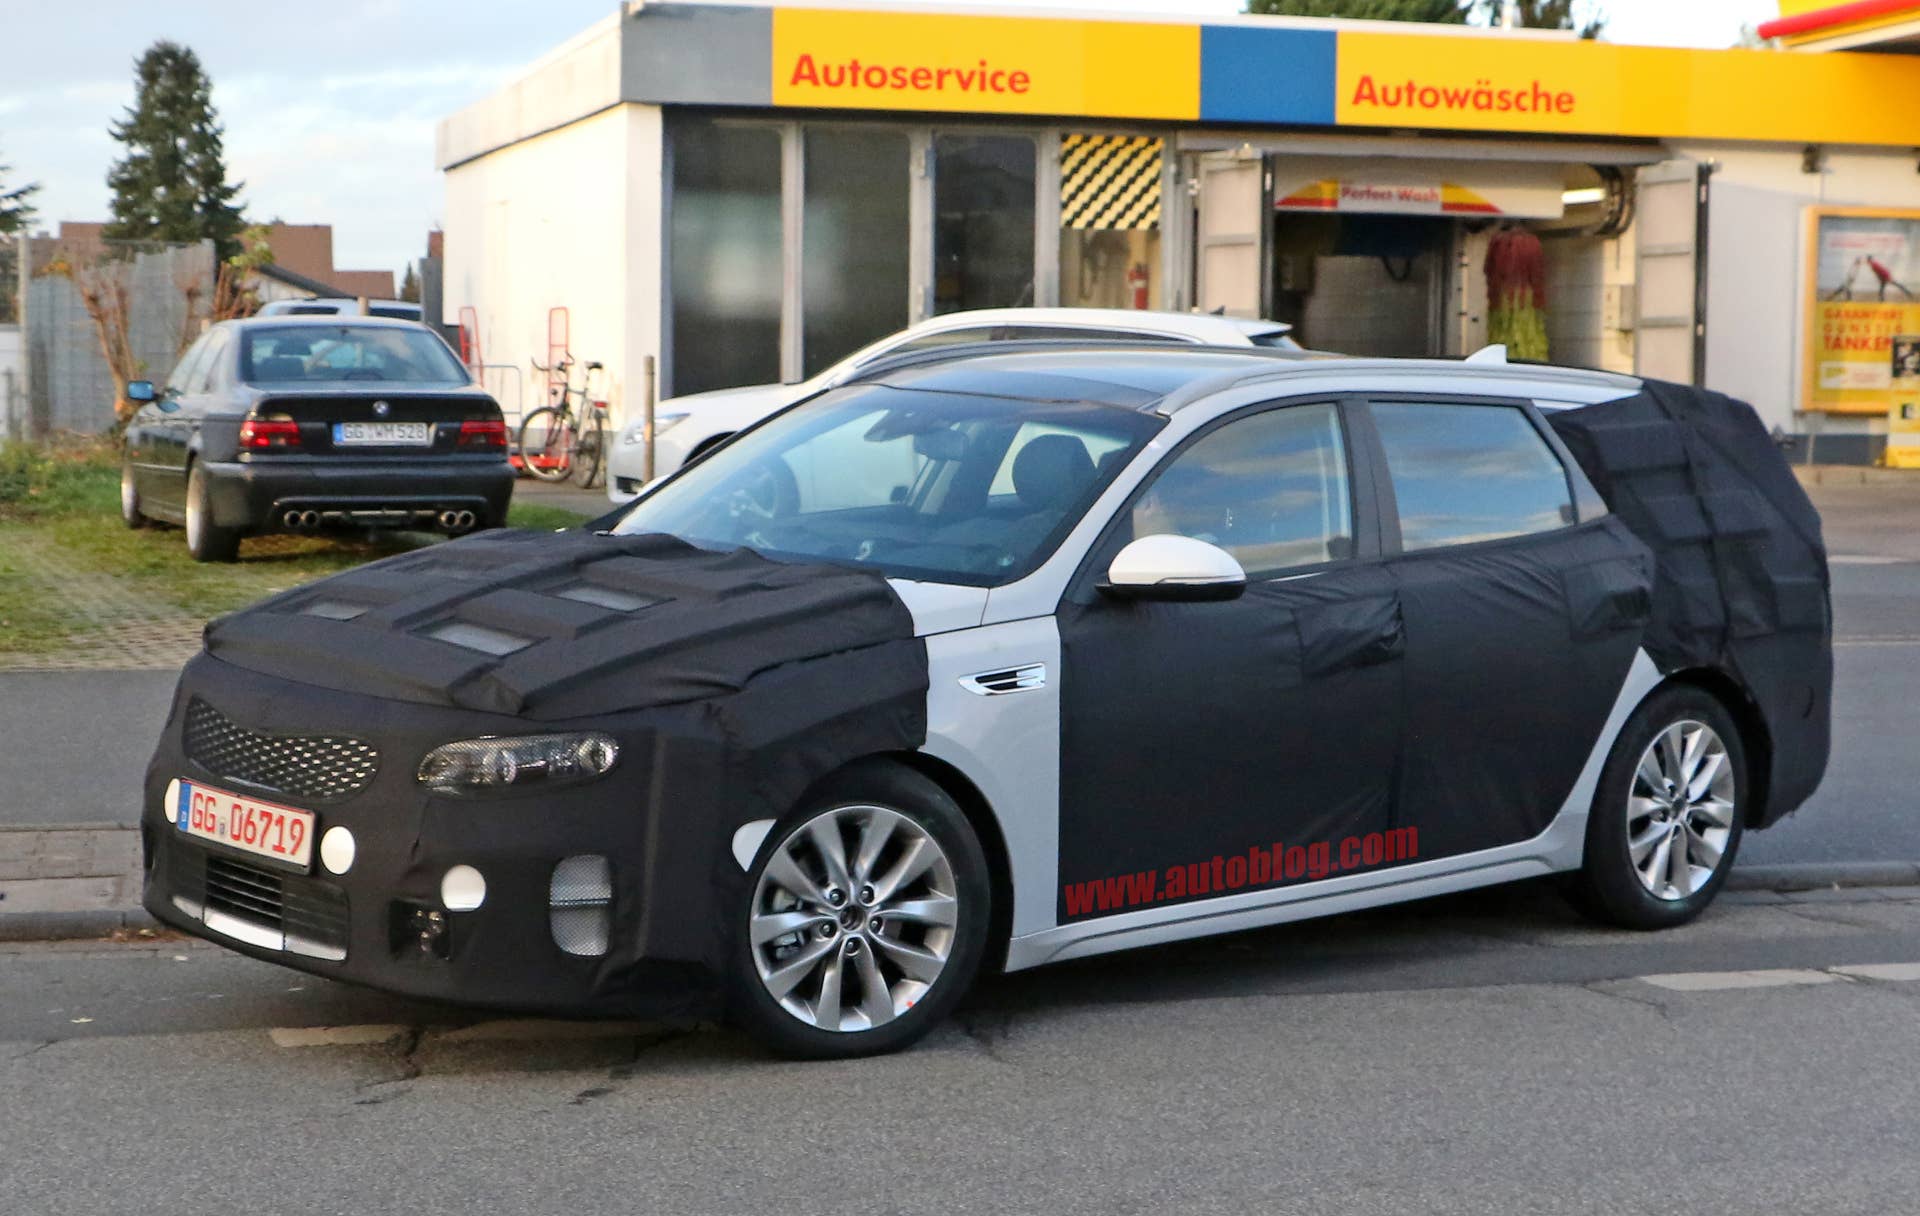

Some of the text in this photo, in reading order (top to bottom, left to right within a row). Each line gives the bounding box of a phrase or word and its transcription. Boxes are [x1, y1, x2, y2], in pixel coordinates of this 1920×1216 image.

[790, 53, 1031, 94] Autoservice
[1351, 75, 1576, 114] Autowäsche
[1398, 186, 1440, 202] Wash
[191, 792, 305, 856] GG 06719
